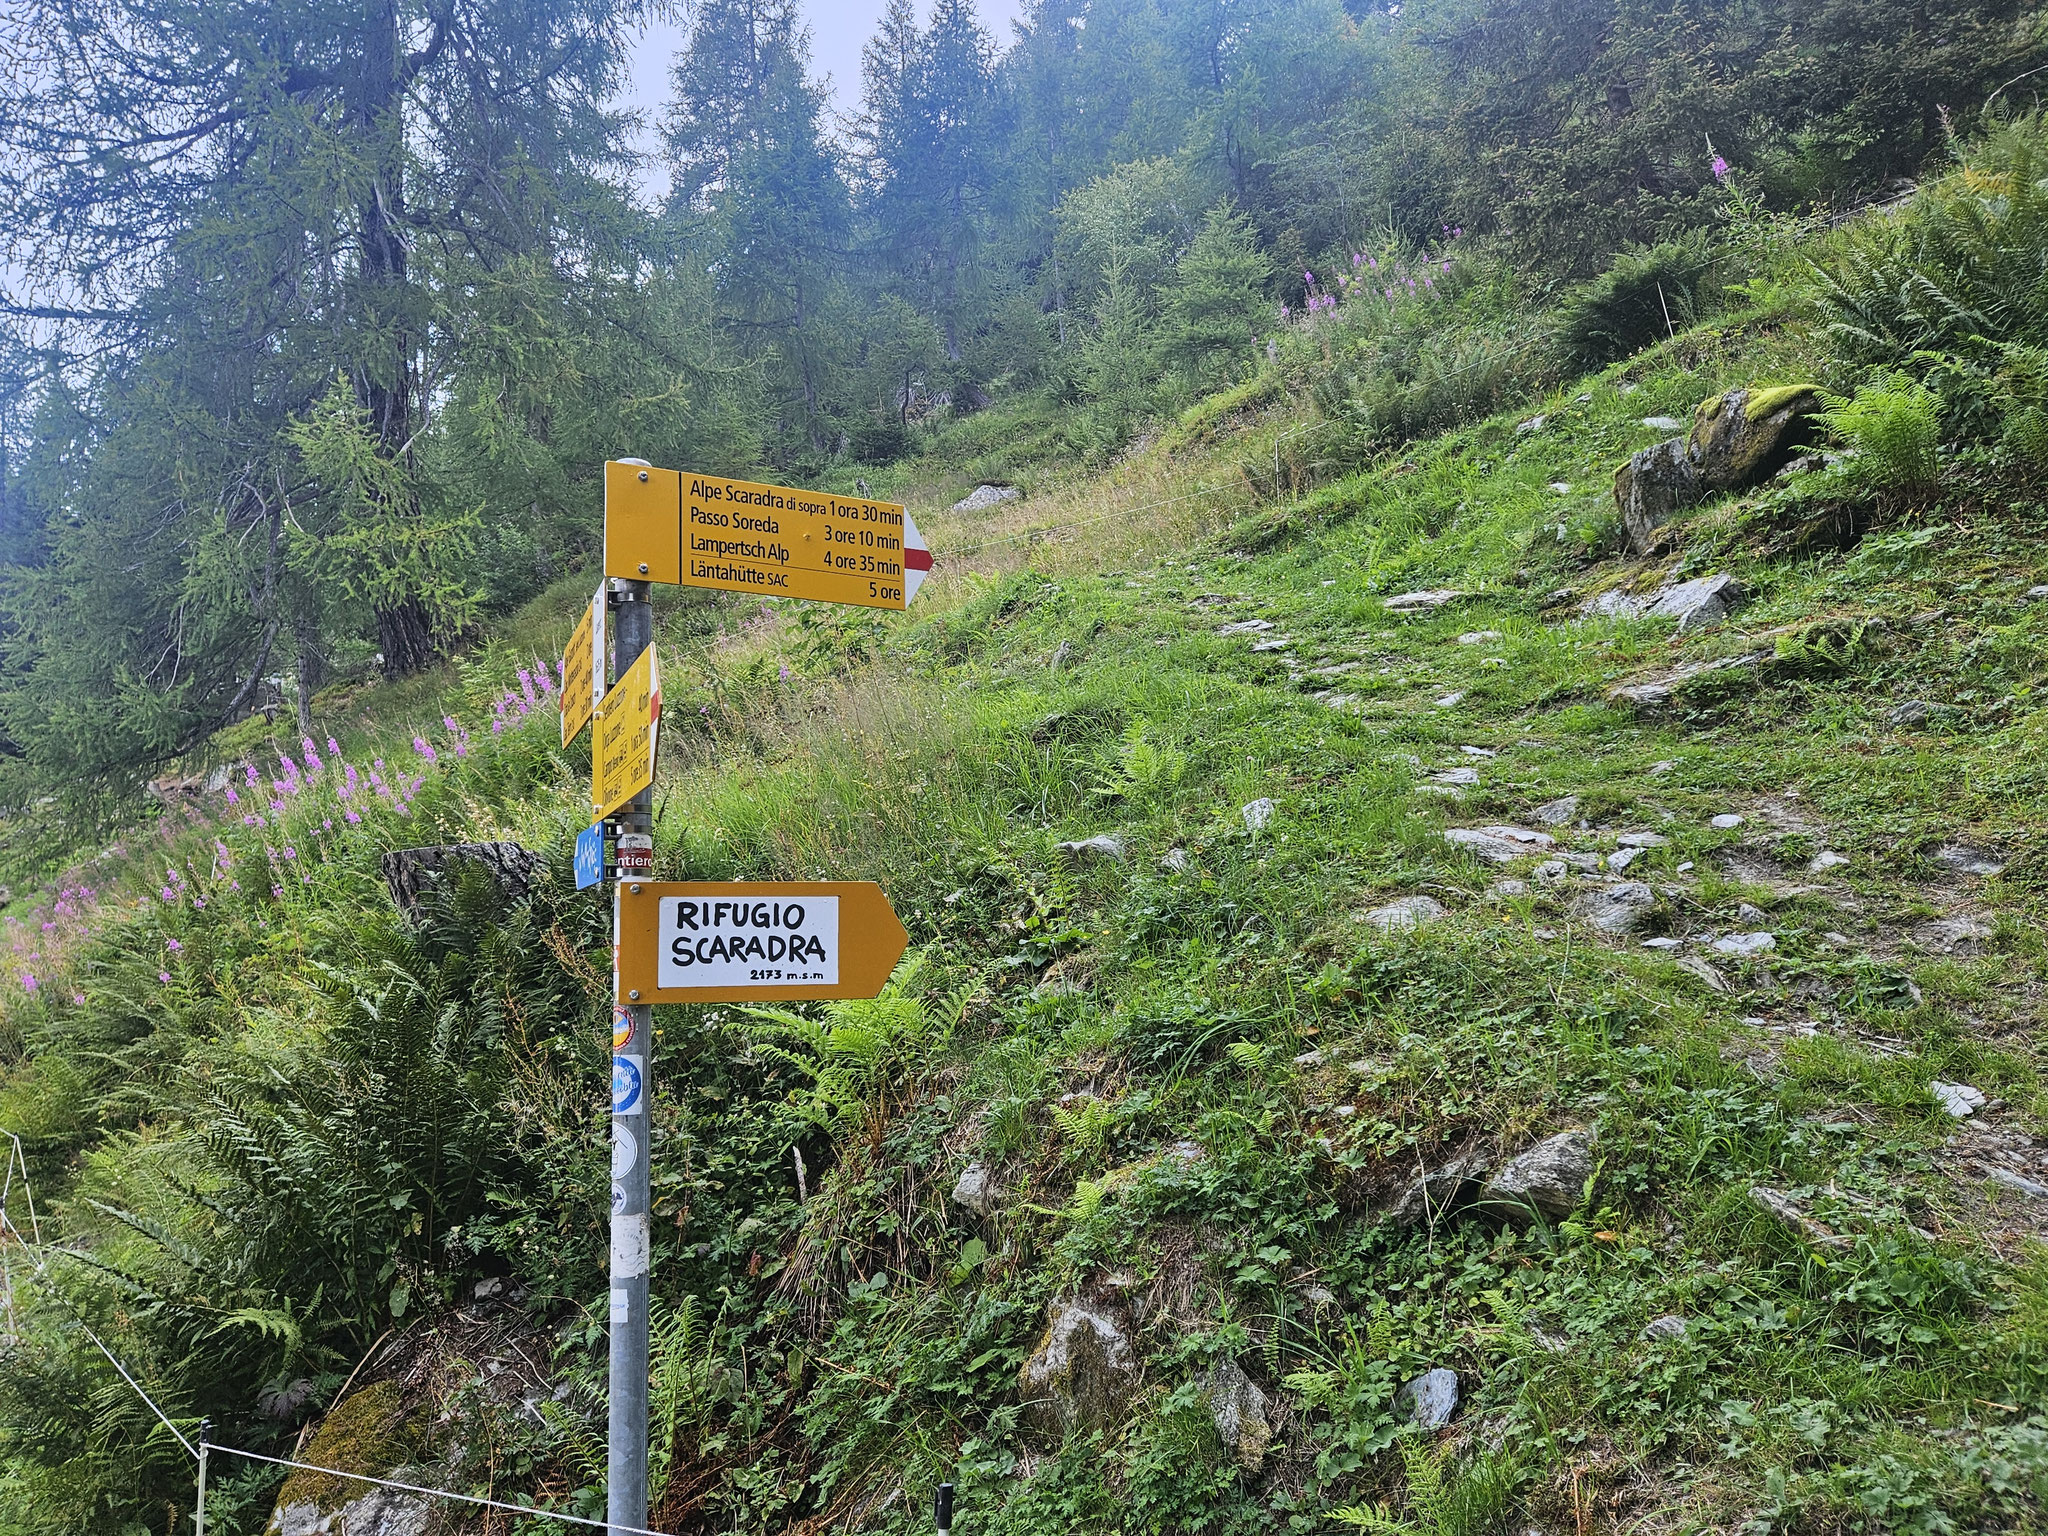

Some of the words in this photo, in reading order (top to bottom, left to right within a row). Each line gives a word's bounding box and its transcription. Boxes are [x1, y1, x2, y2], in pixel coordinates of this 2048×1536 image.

[690, 480, 722, 503] Alpe
[725, 484, 784, 509] Scaradra
[786, 496, 796, 511] di
[798, 501, 827, 517] sopra
[829, 501, 835, 516] 1
[838, 505, 858, 520] ora
[862, 505, 878, 522] 30
[879, 508, 903, 526] min
[690, 506, 729, 527] Passo
[732, 512, 779, 534] Soreda
[824, 525, 832, 541] 3
[835, 529, 856, 544] ore
[859, 530, 873, 547] 10
[876, 533, 900, 550] min
[690, 533, 766, 558] Lampertsch
[768, 543, 790, 565] Alp
[824, 551, 833, 567] 4
[835, 555, 856, 570] ore
[859, 555, 875, 572] 35
[877, 558, 900, 576] min
[690, 559, 765, 584] Läntahütte
[767, 572, 789, 588] SAC
[869, 581, 876, 598] 5
[880, 586, 901, 601] ore
[676, 901, 805, 931] RIFUGIO
[671, 935, 826, 966] SCARADRA
[750, 969, 782, 980] 2173
